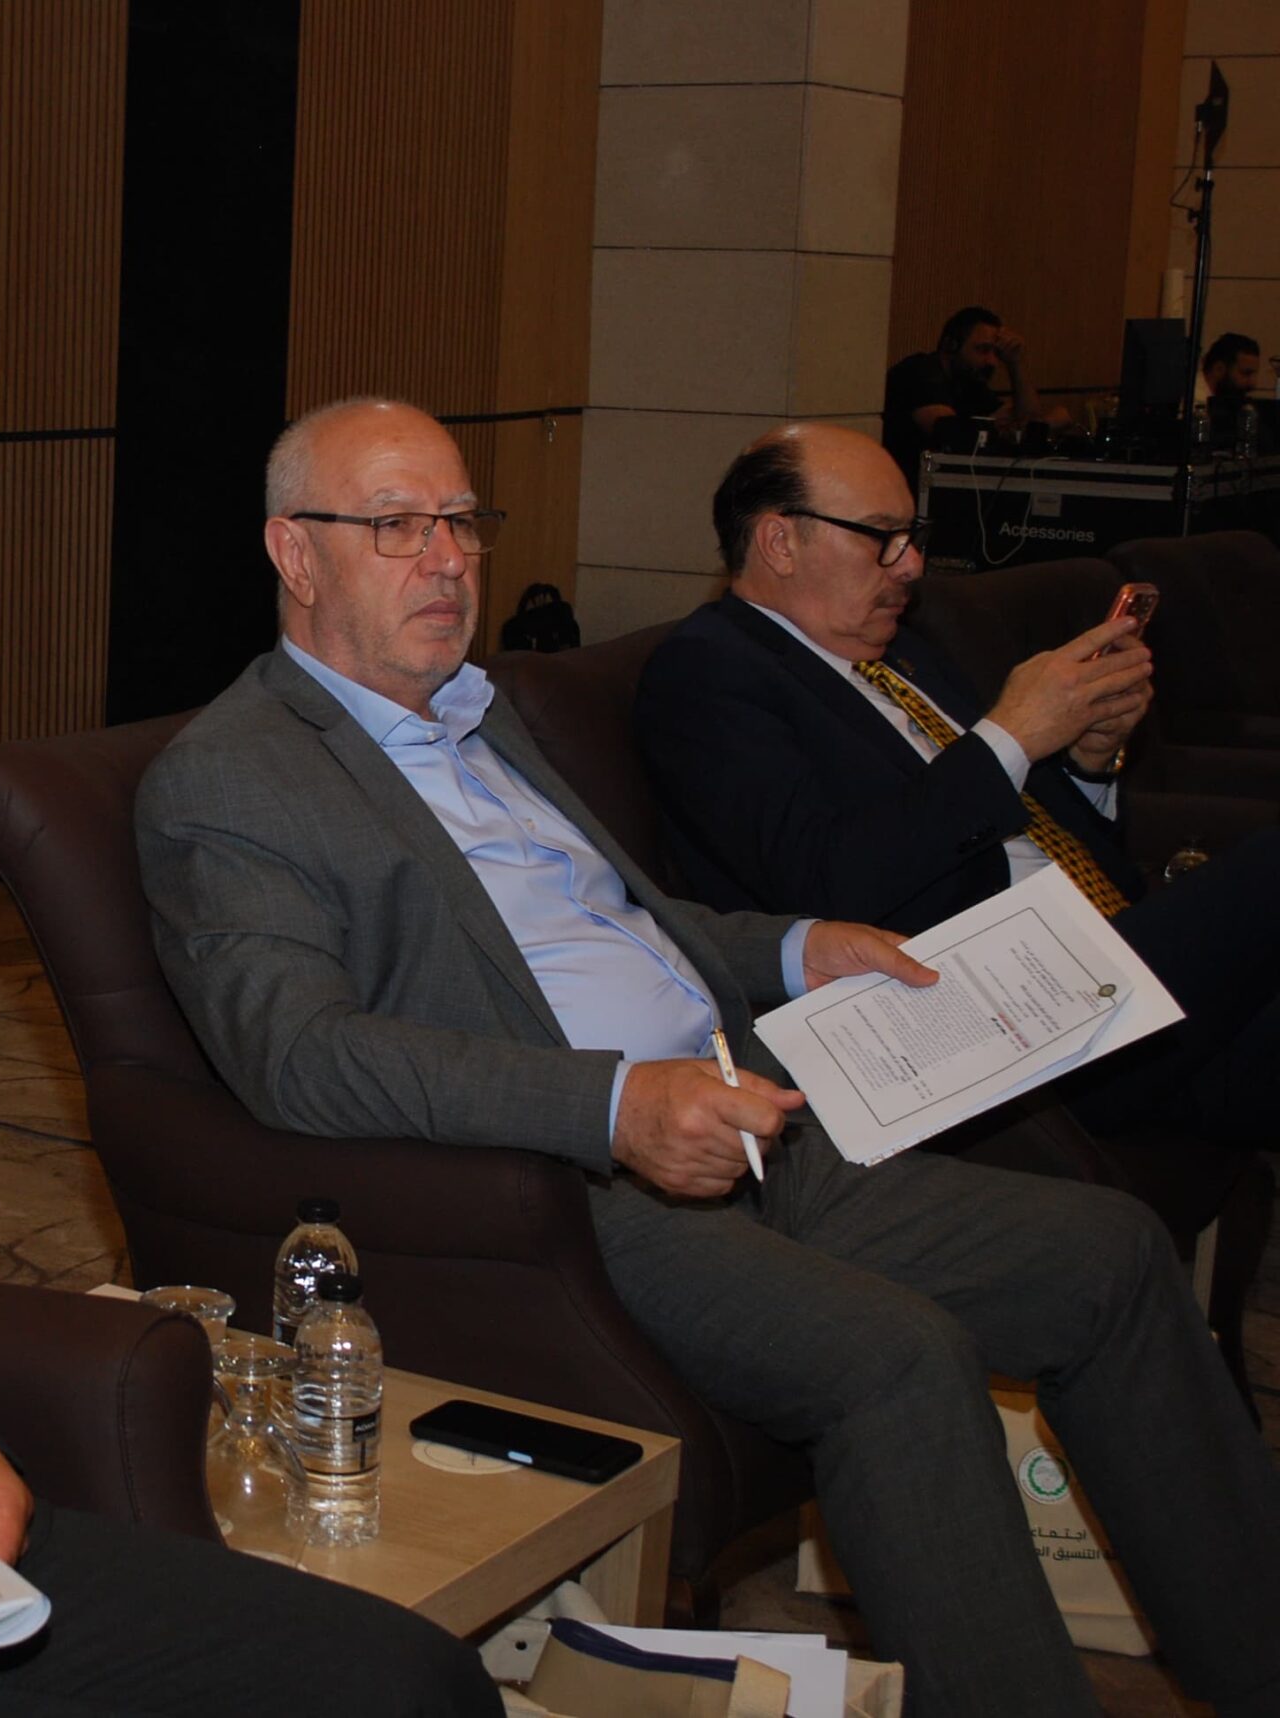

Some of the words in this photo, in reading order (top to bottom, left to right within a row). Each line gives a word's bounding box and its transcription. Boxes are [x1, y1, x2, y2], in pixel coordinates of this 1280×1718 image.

[999, 522, 1095, 543] Accessories
[1030, 1527, 1086, 1542] اجتماع
[1052, 1546, 1099, 1561] التنسيق
